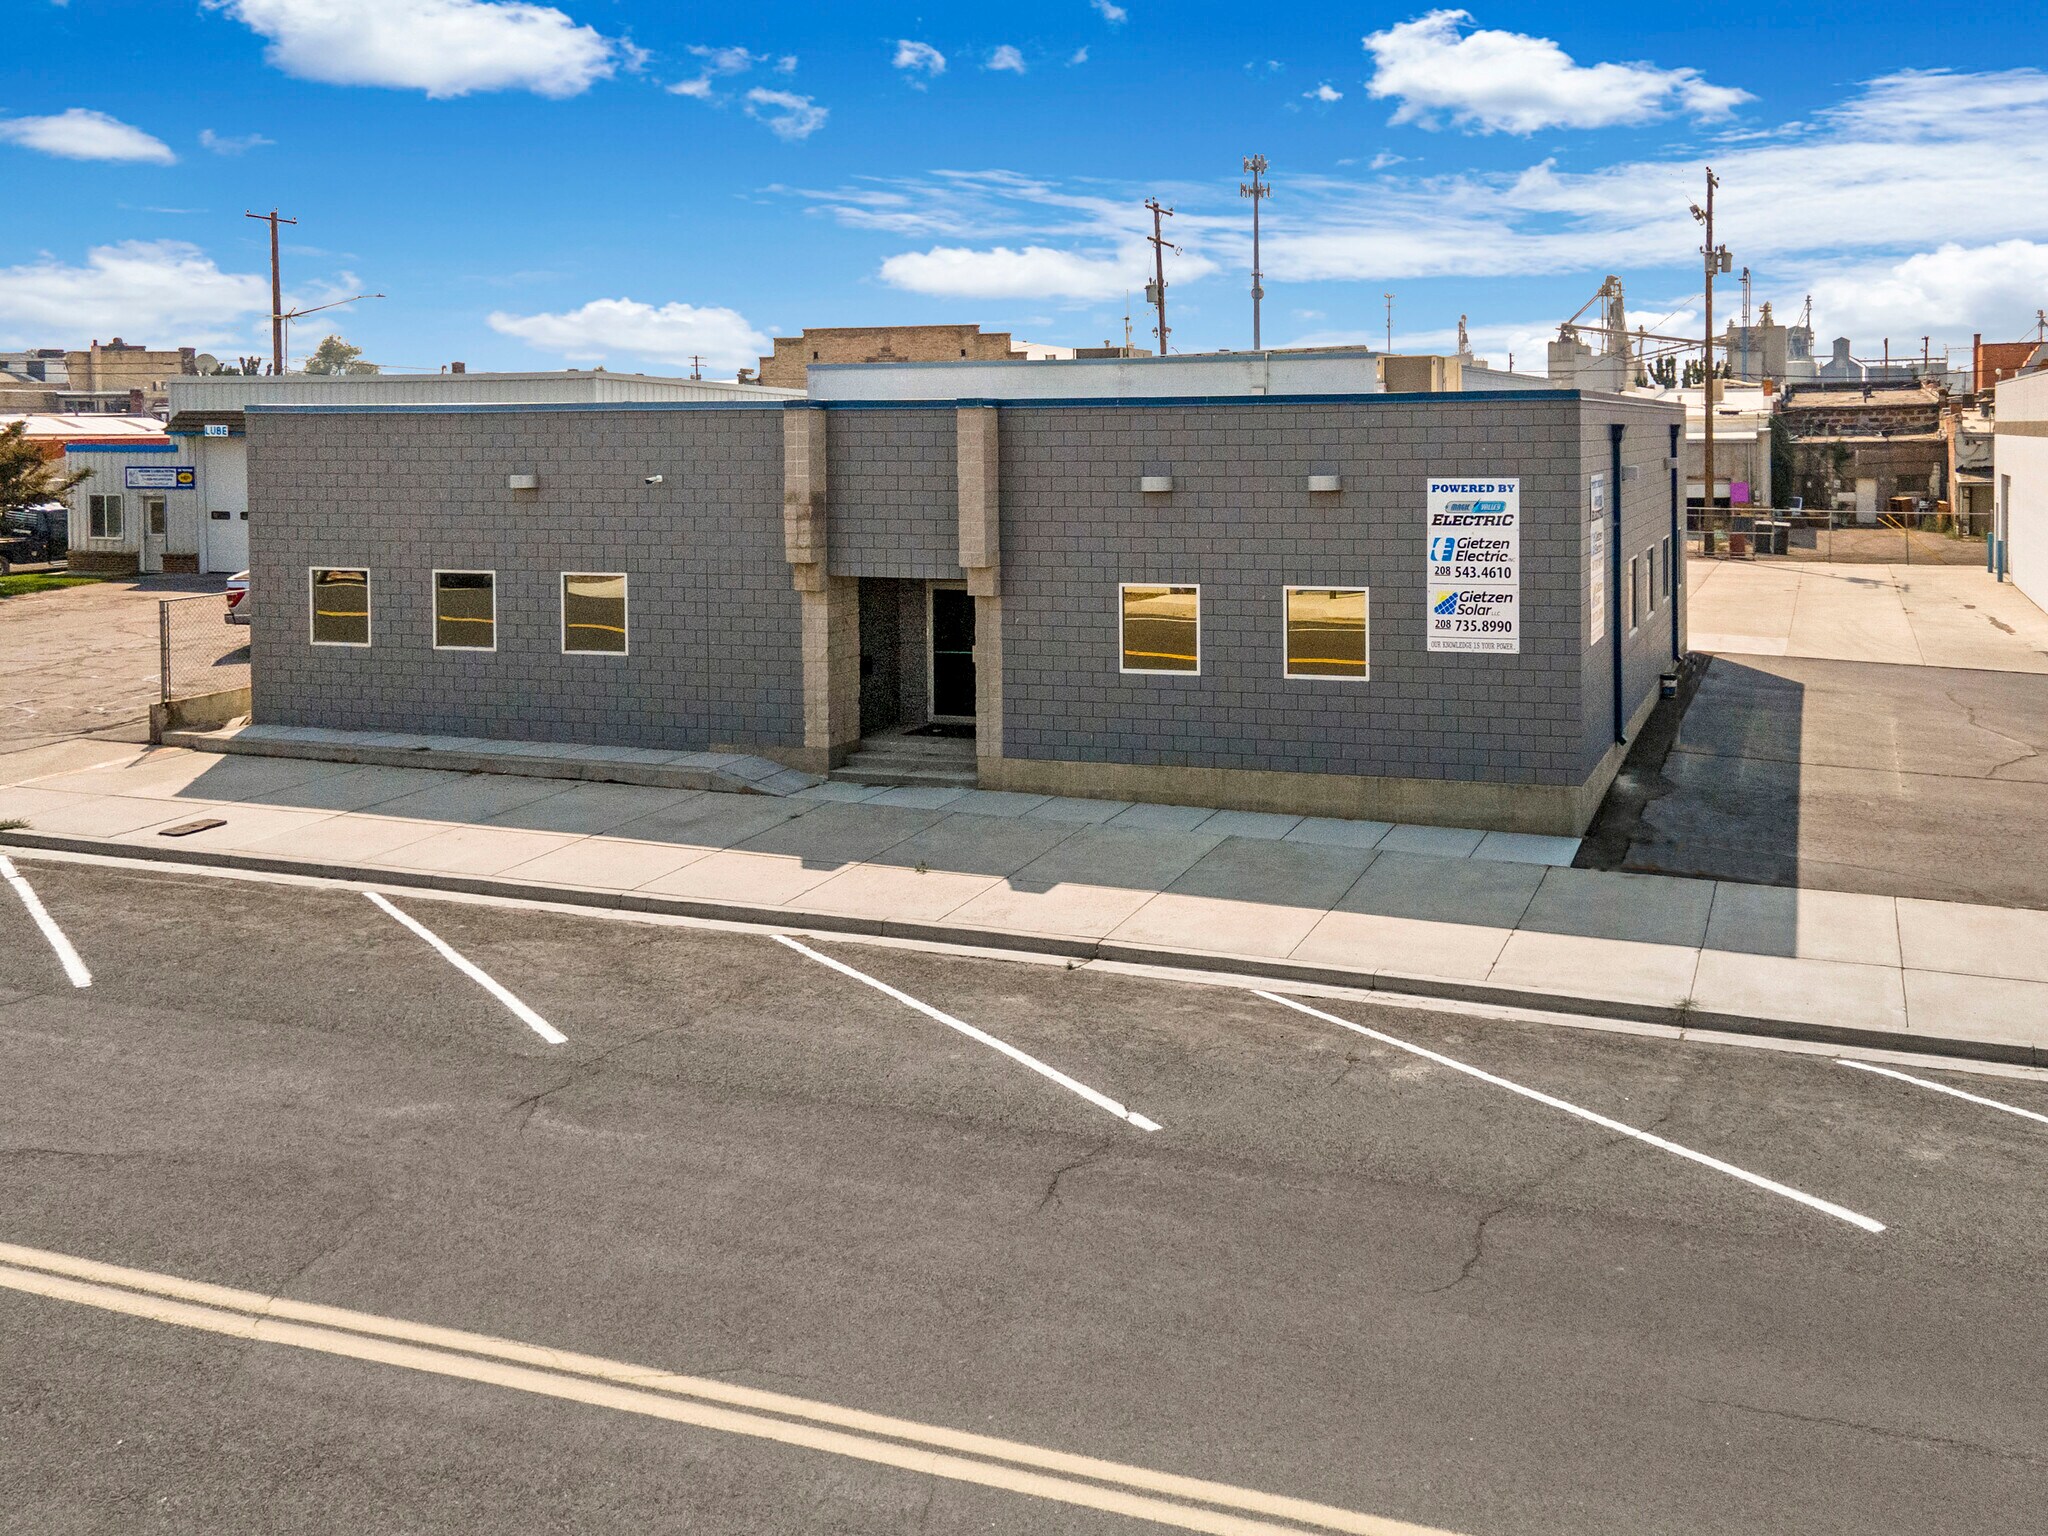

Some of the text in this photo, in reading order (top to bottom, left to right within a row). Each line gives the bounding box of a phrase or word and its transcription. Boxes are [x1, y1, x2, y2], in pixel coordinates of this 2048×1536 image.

[205, 426, 227, 435] LUBE
[1431, 484, 1515, 493] POWERED BY
[1431, 514, 1514, 526] ELECTRIC
[1457, 537, 1510, 549] Gietzen
[1455, 550, 1508, 562] Electric
[1434, 566, 1512, 578] 208 543.4610
[1459, 590, 1513, 603] Gietzen
[1456, 604, 1492, 615] Solar
[1435, 619, 1512, 632] 208 735.8990
[1442, 641, 1472, 649] KNOWLEDGE
